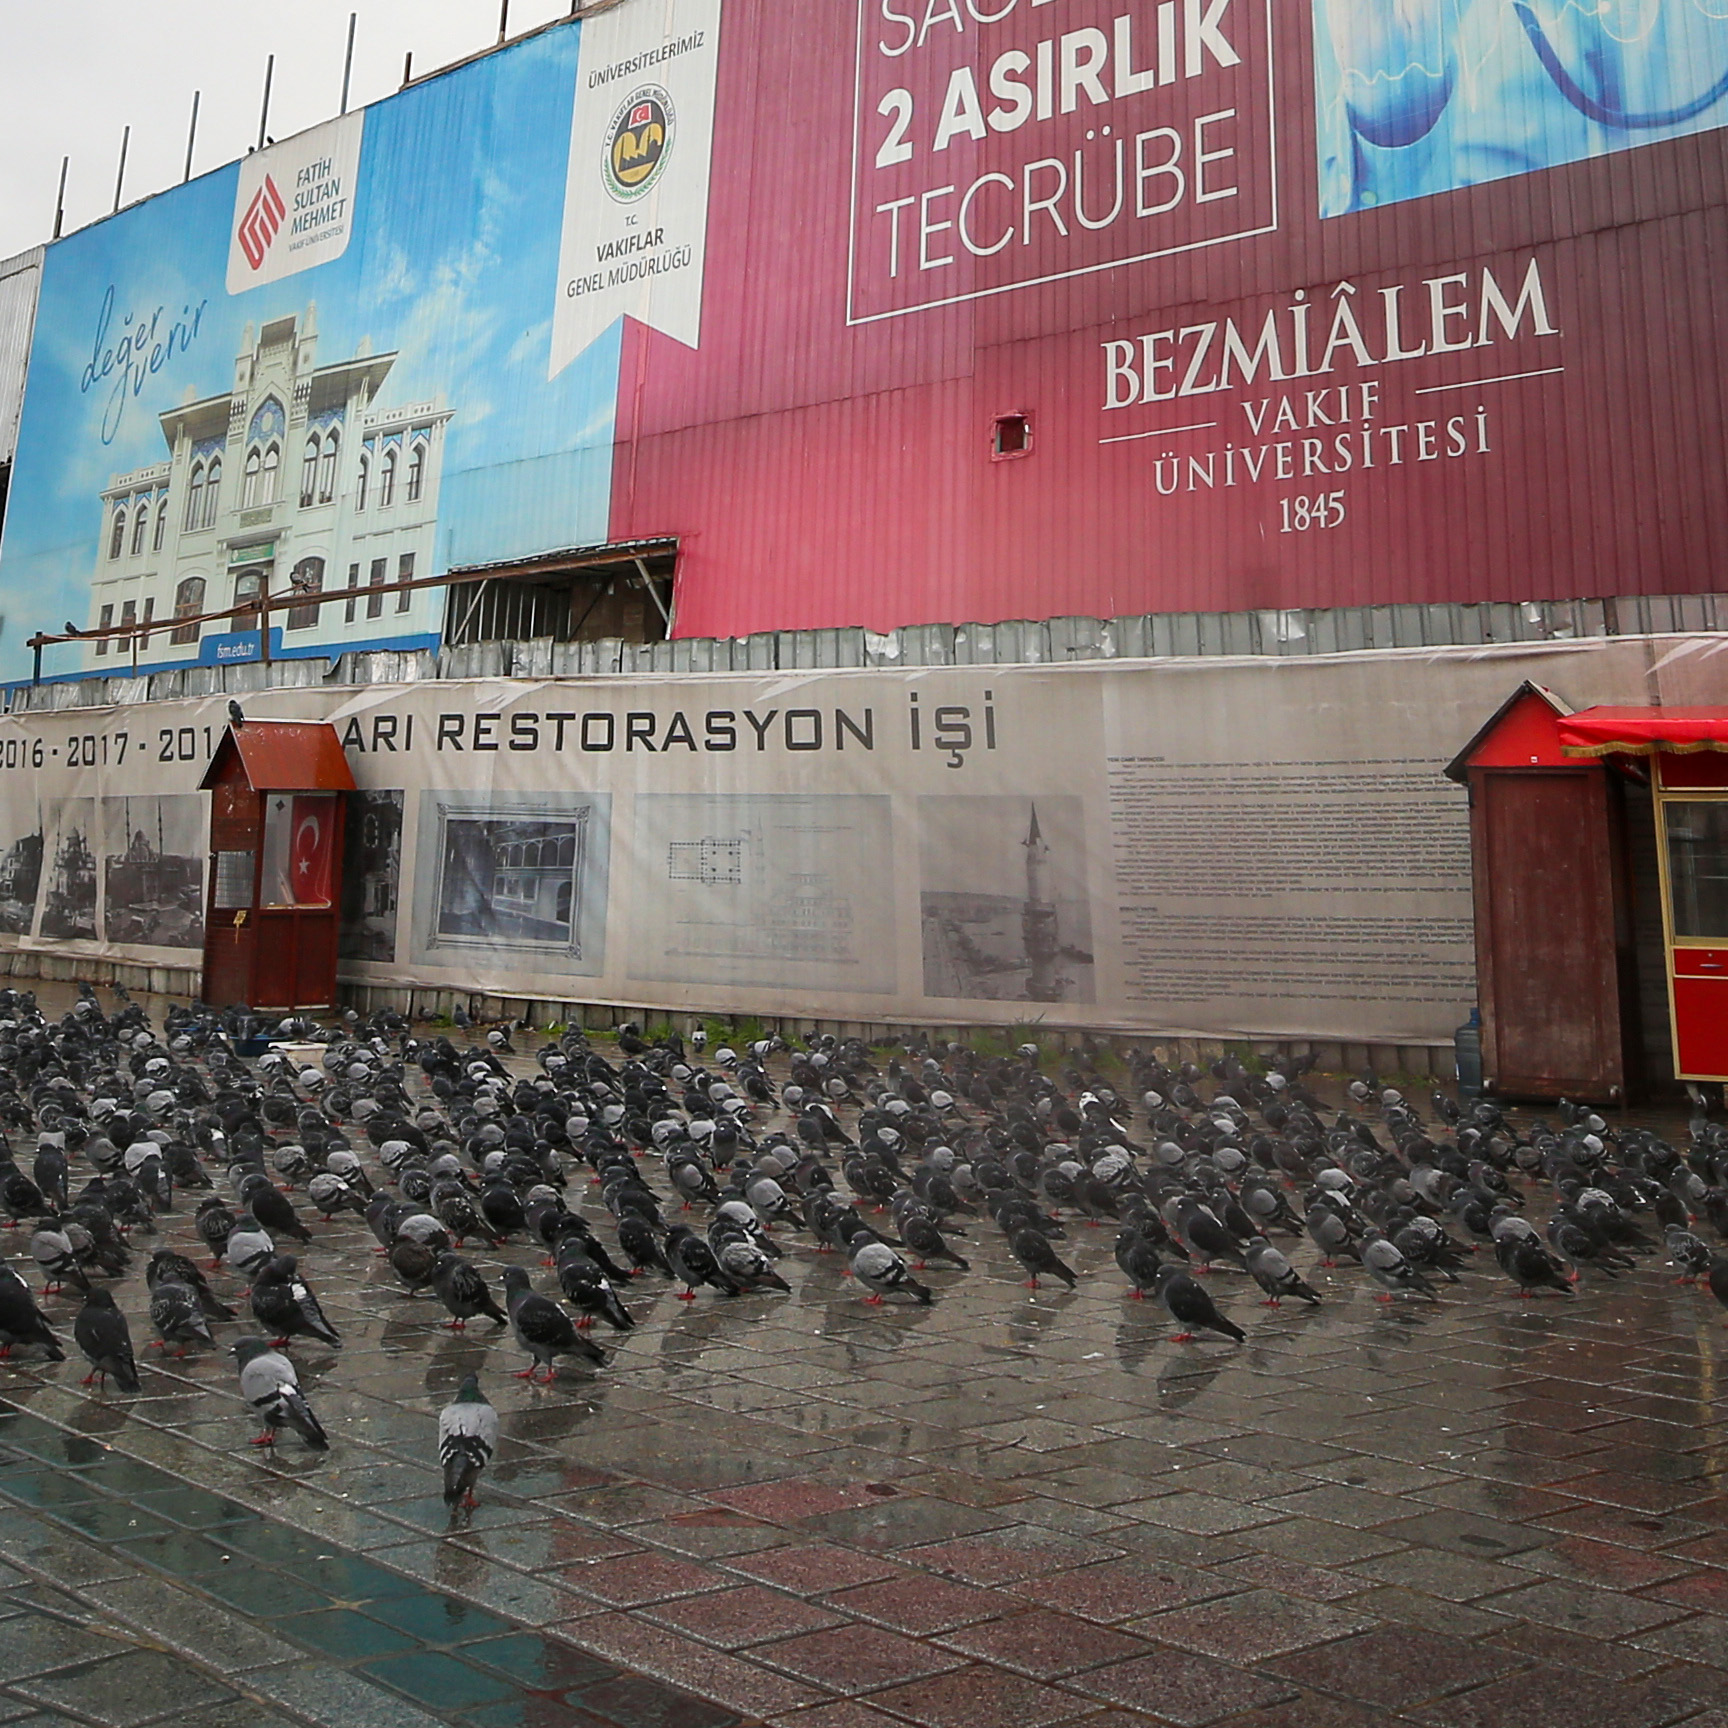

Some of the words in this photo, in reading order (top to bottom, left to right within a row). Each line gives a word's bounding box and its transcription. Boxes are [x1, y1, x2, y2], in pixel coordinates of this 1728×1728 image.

[587, 30, 705, 89] ÜNİVERSİTELERİMİZ
[874, 87, 915, 170] 2
[292, 177, 341, 212] SULTAN
[296, 156, 332, 189] FATİH
[875, 107, 1239, 278] TECRÜBE
[290, 197, 348, 236] MEHMET
[596, 227, 665, 263] VAKIFLAR
[566, 273, 605, 299] GENEL
[607, 243, 693, 288] MÜDÜRLÜĞÜ
[1099, 256, 1560, 412] BEZMİÂLEM
[80, 283, 165, 446] değer
[1239, 379, 1381, 437] VAKIF
[1152, 404, 1492, 496] ÜNİVERSİTESİ
[1278, 488, 1347, 534] 1845
[216, 642, 256, 660] fsm.edu.tr
[66, 731, 129, 768] 2017
[158, 725, 214, 763] 201
[436, 708, 875, 753] RESTORASYON
[909, 689, 997, 769] İŞİ
